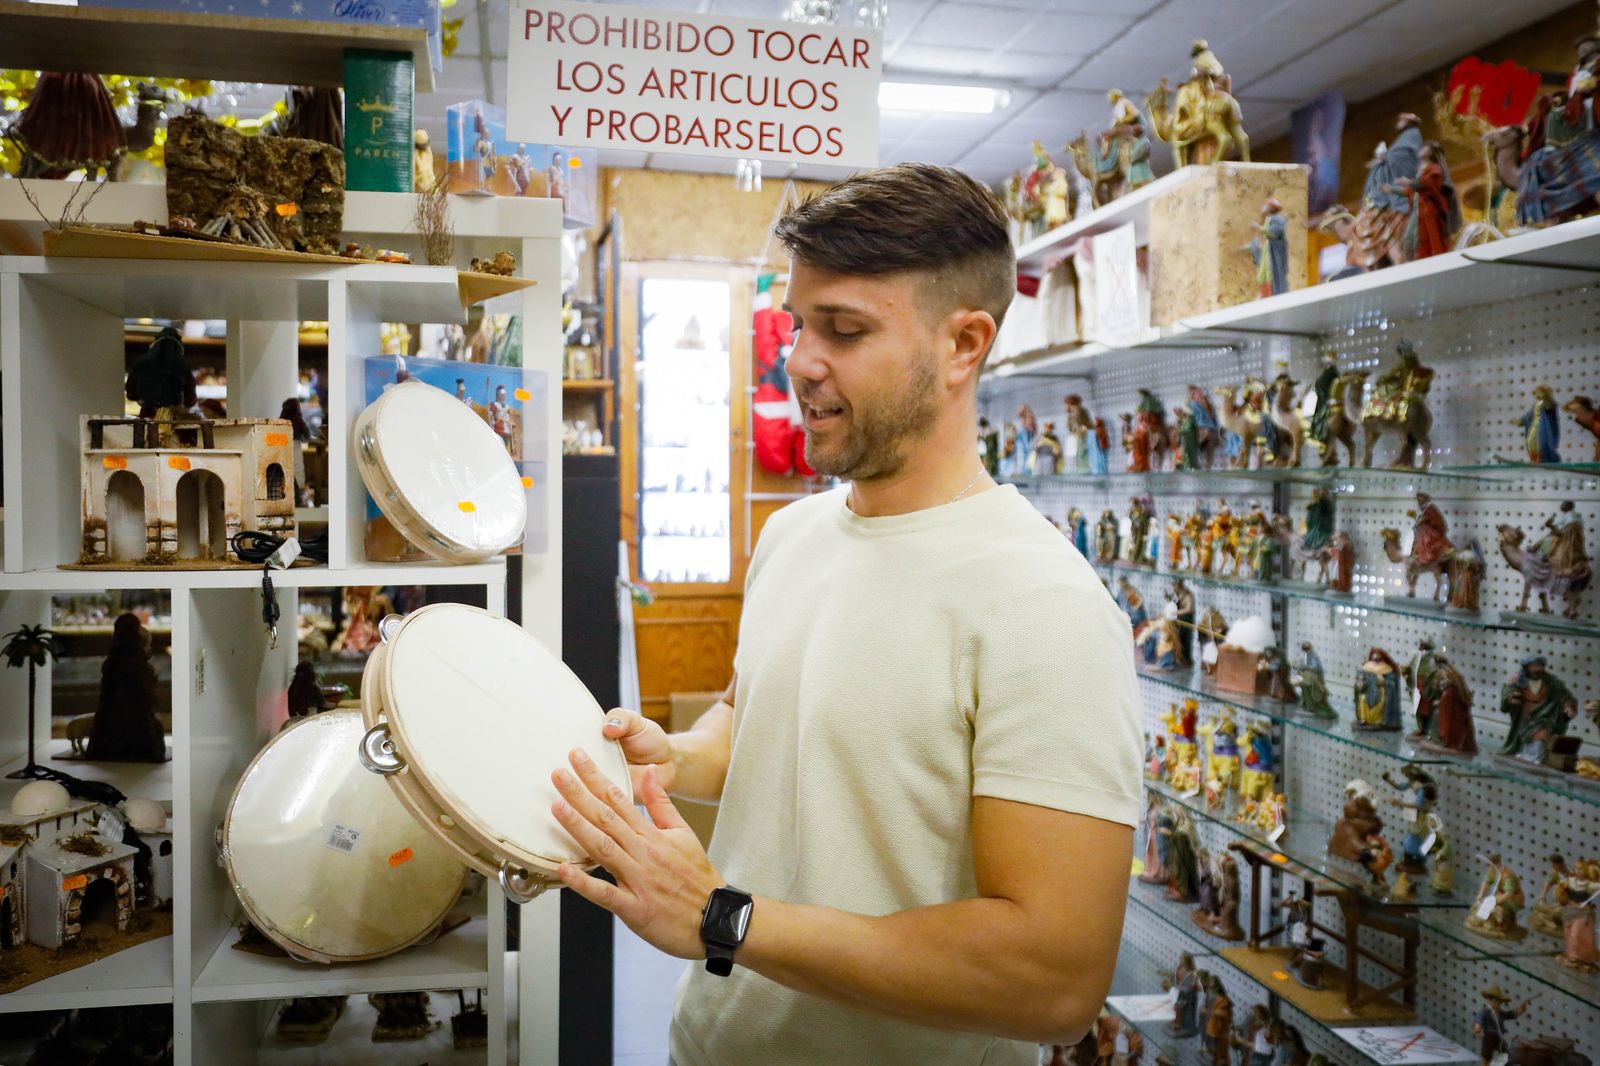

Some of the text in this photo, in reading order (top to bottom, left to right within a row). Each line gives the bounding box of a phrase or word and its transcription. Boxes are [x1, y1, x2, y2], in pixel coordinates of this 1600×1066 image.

[524, 8, 871, 70] PROHIBIDO TOCAR
[555, 59, 840, 113] LOS ARTICULOS
[370, 116, 384, 136] P
[550, 104, 845, 158] Y PROBARSELOS
